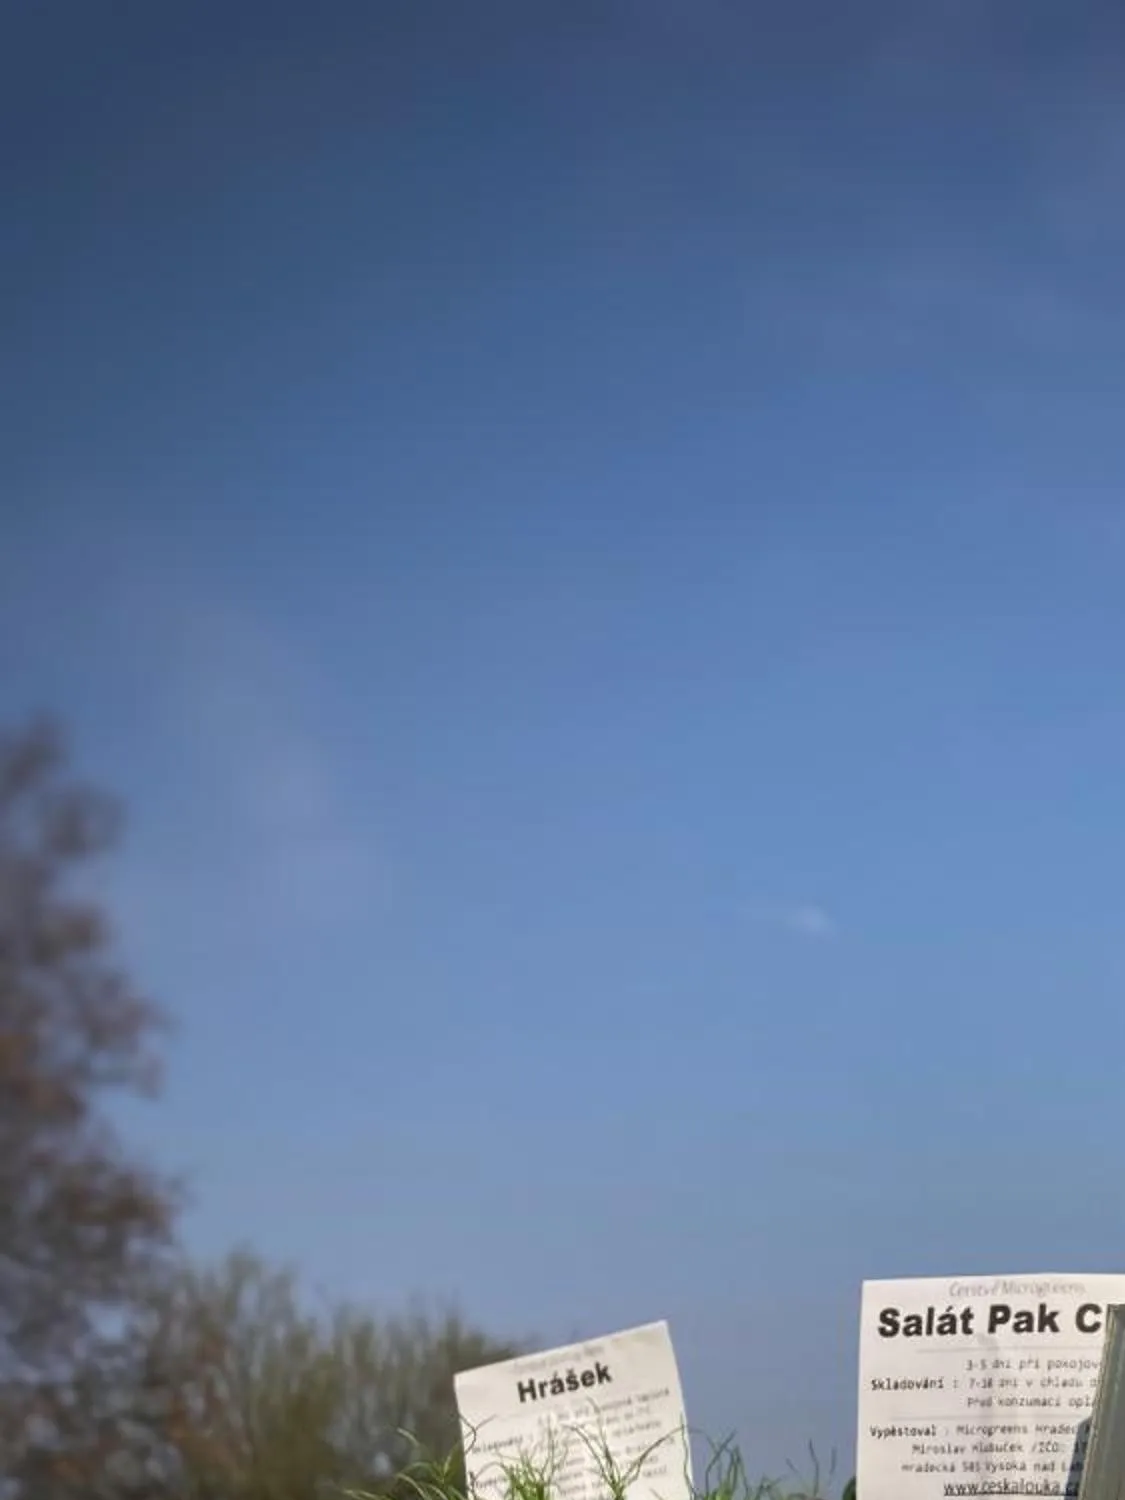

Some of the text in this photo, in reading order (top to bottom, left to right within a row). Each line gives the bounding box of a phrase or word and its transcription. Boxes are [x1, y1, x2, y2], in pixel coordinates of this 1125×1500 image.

[878, 1306, 974, 1337] Salát
[988, 1303, 1060, 1334] Pak
[516, 1361, 614, 1404] Hrášek
